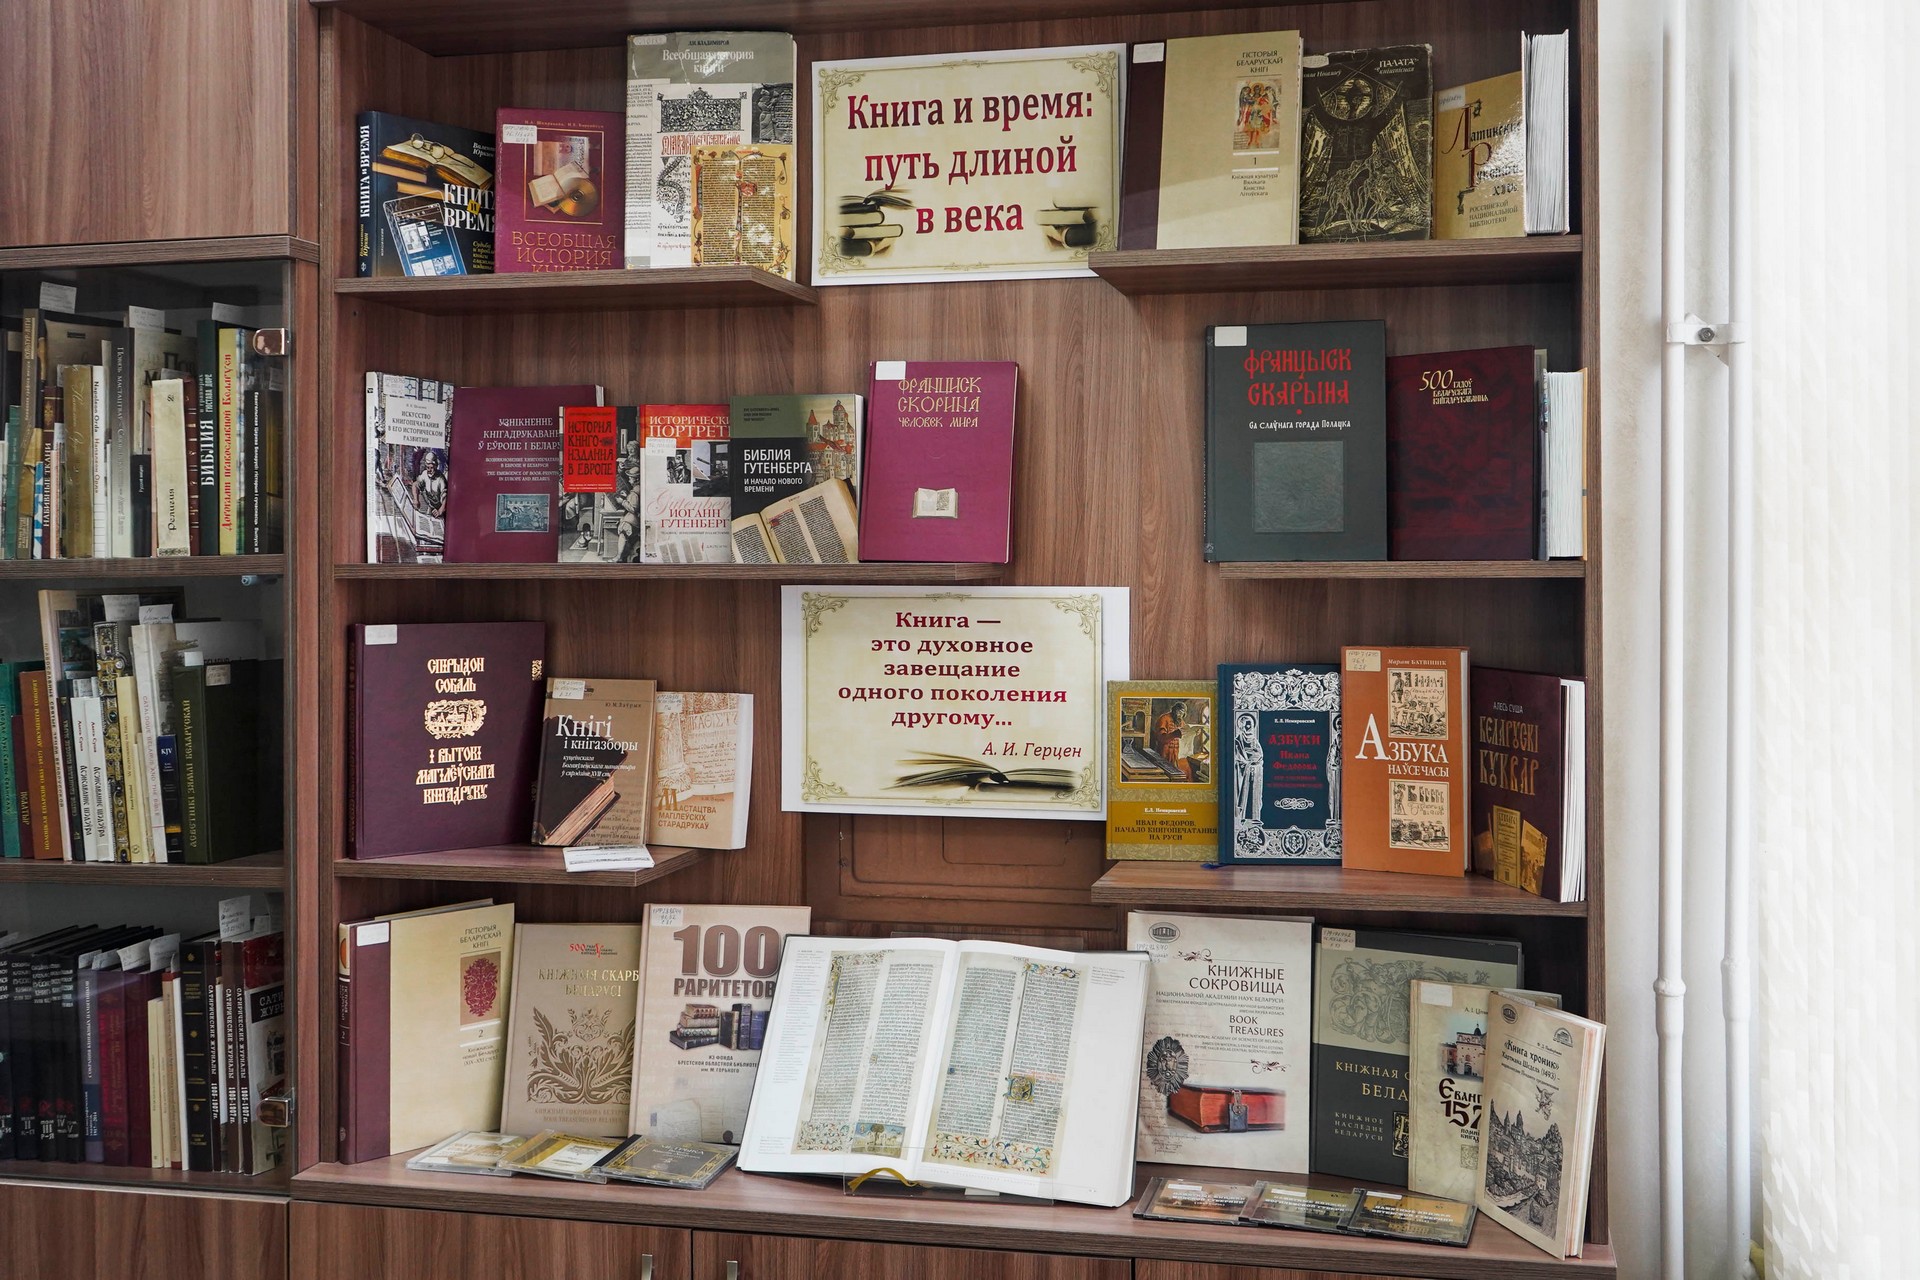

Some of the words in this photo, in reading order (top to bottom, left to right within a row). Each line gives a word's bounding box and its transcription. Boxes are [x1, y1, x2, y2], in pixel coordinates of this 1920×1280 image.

[1236, 57, 1283, 66] БЕЛАРУСКАЙ
[1242, 50, 1278, 58] ГІСТОРЫЯ
[847, 94, 944, 129] Книга
[954, 97, 973, 124] и
[982, 91, 1093, 131] время:
[360, 125, 370, 168] ВРЕМЯ
[865, 152, 939, 190] путь
[948, 135, 1077, 186] длиной
[360, 176, 370, 218] КНИГА
[916, 207, 934, 234] в
[944, 202, 1024, 233] века
[511, 231, 616, 249] ВСЕОБЩАЯ
[517, 247, 611, 265] ИСТОРИЯ
[1243, 348, 1352, 379] ФРАНЦЫСК
[898, 376, 982, 395] ФРАНЦИСК
[1419, 369, 1454, 391] 500
[1247, 380, 1349, 406] СКАРЫНА
[898, 396, 980, 413] СКОРИНА
[401, 411, 431, 420] ИСКУССТВО
[498, 418, 553, 427] УЗНІКНЕННЕ
[898, 416, 943, 428] ЧЕЛОВЕК
[949, 416, 979, 428] МИРА
[568, 421, 612, 433] ИСТОРИЯ
[200, 419, 215, 486] БИБЛИЯ
[222, 410, 232, 477] православной
[487, 440, 522, 451] ЕЎРОПЕ
[568, 448, 613, 462] ИЗДАНИЯ
[744, 449, 791, 461] БИБЛИЯ
[568, 463, 574, 475] В
[578, 463, 613, 475] ЕВРОПЕ
[744, 462, 813, 474] ГУТЕНБЕРГА
[744, 485, 774, 493] ВРЕМЕНИ
[778, 477, 803, 485] НОВОГО
[43, 477, 51, 527] НАБИВНЫЕ
[669, 508, 721, 518] ИОГАНН
[661, 519, 730, 529] ГУТЕНБЕРГ
[895, 611, 970, 629] Книга
[871, 639, 911, 652] это
[917, 639, 1034, 656] духовное
[883, 662, 1021, 679] завещание
[838, 685, 924, 702] одного
[931, 689, 1067, 703] поколения
[142, 695, 151, 734] CATALOGUE
[891, 710, 1013, 729] другому...
[183, 699, 195, 759] БЕЛАРУСКАЙ
[555, 713, 612, 737] Кнігі
[570, 737, 639, 754] кнігазборы
[1269, 734, 1321, 747] АЗБУКИ
[1355, 713, 1449, 763] АЗБУКА
[982, 742, 997, 756] А.
[1002, 743, 1020, 757] И.
[1023, 743, 1082, 761] Герцен
[1279, 750, 1310, 759] Ивана
[186, 763, 194, 794] ЗЯМЛІ
[1387, 764, 1402, 775] НА
[1402, 762, 1421, 776] ЎСЕ
[1421, 765, 1449, 777] ЧАСЫ
[1479, 749, 1540, 796] БУКВАР
[187, 796, 197, 848] АСВЕТНІКІ
[658, 820, 709, 830] СТАРАДРУКАЎ
[569, 943, 586, 952] 500
[673, 924, 782, 978] 100
[1207, 964, 1285, 981] КНИЖНЫЕ
[674, 978, 777, 998] РАРИТЕТОВ
[1189, 977, 1285, 995] СОКРОВИЩА
[225, 988, 233, 1042] САТИРИЧЕСКИЕ
[236, 987, 245, 1042] САТИРИЧЕСКИЕ
[1229, 1014, 1258, 1024] BOOK
[478, 1029, 484, 1038] 2
[1229, 1025, 1285, 1038] TREASURES
[227, 1044, 235, 1079] ЖУРНАЛЫ
[239, 1044, 247, 1079] ЖУРНАЛЫ
[1335, 1060, 1399, 1079] КНІЖНАЯ
[1361, 1082, 1408, 1102] БЕЛА
[1334, 1111, 1384, 1125] КНИЖНОЕ
[1334, 1119, 1384, 1134] НАСЛЕДИЕ
[1334, 1127, 1384, 1142] БЕЛАРУСИ
